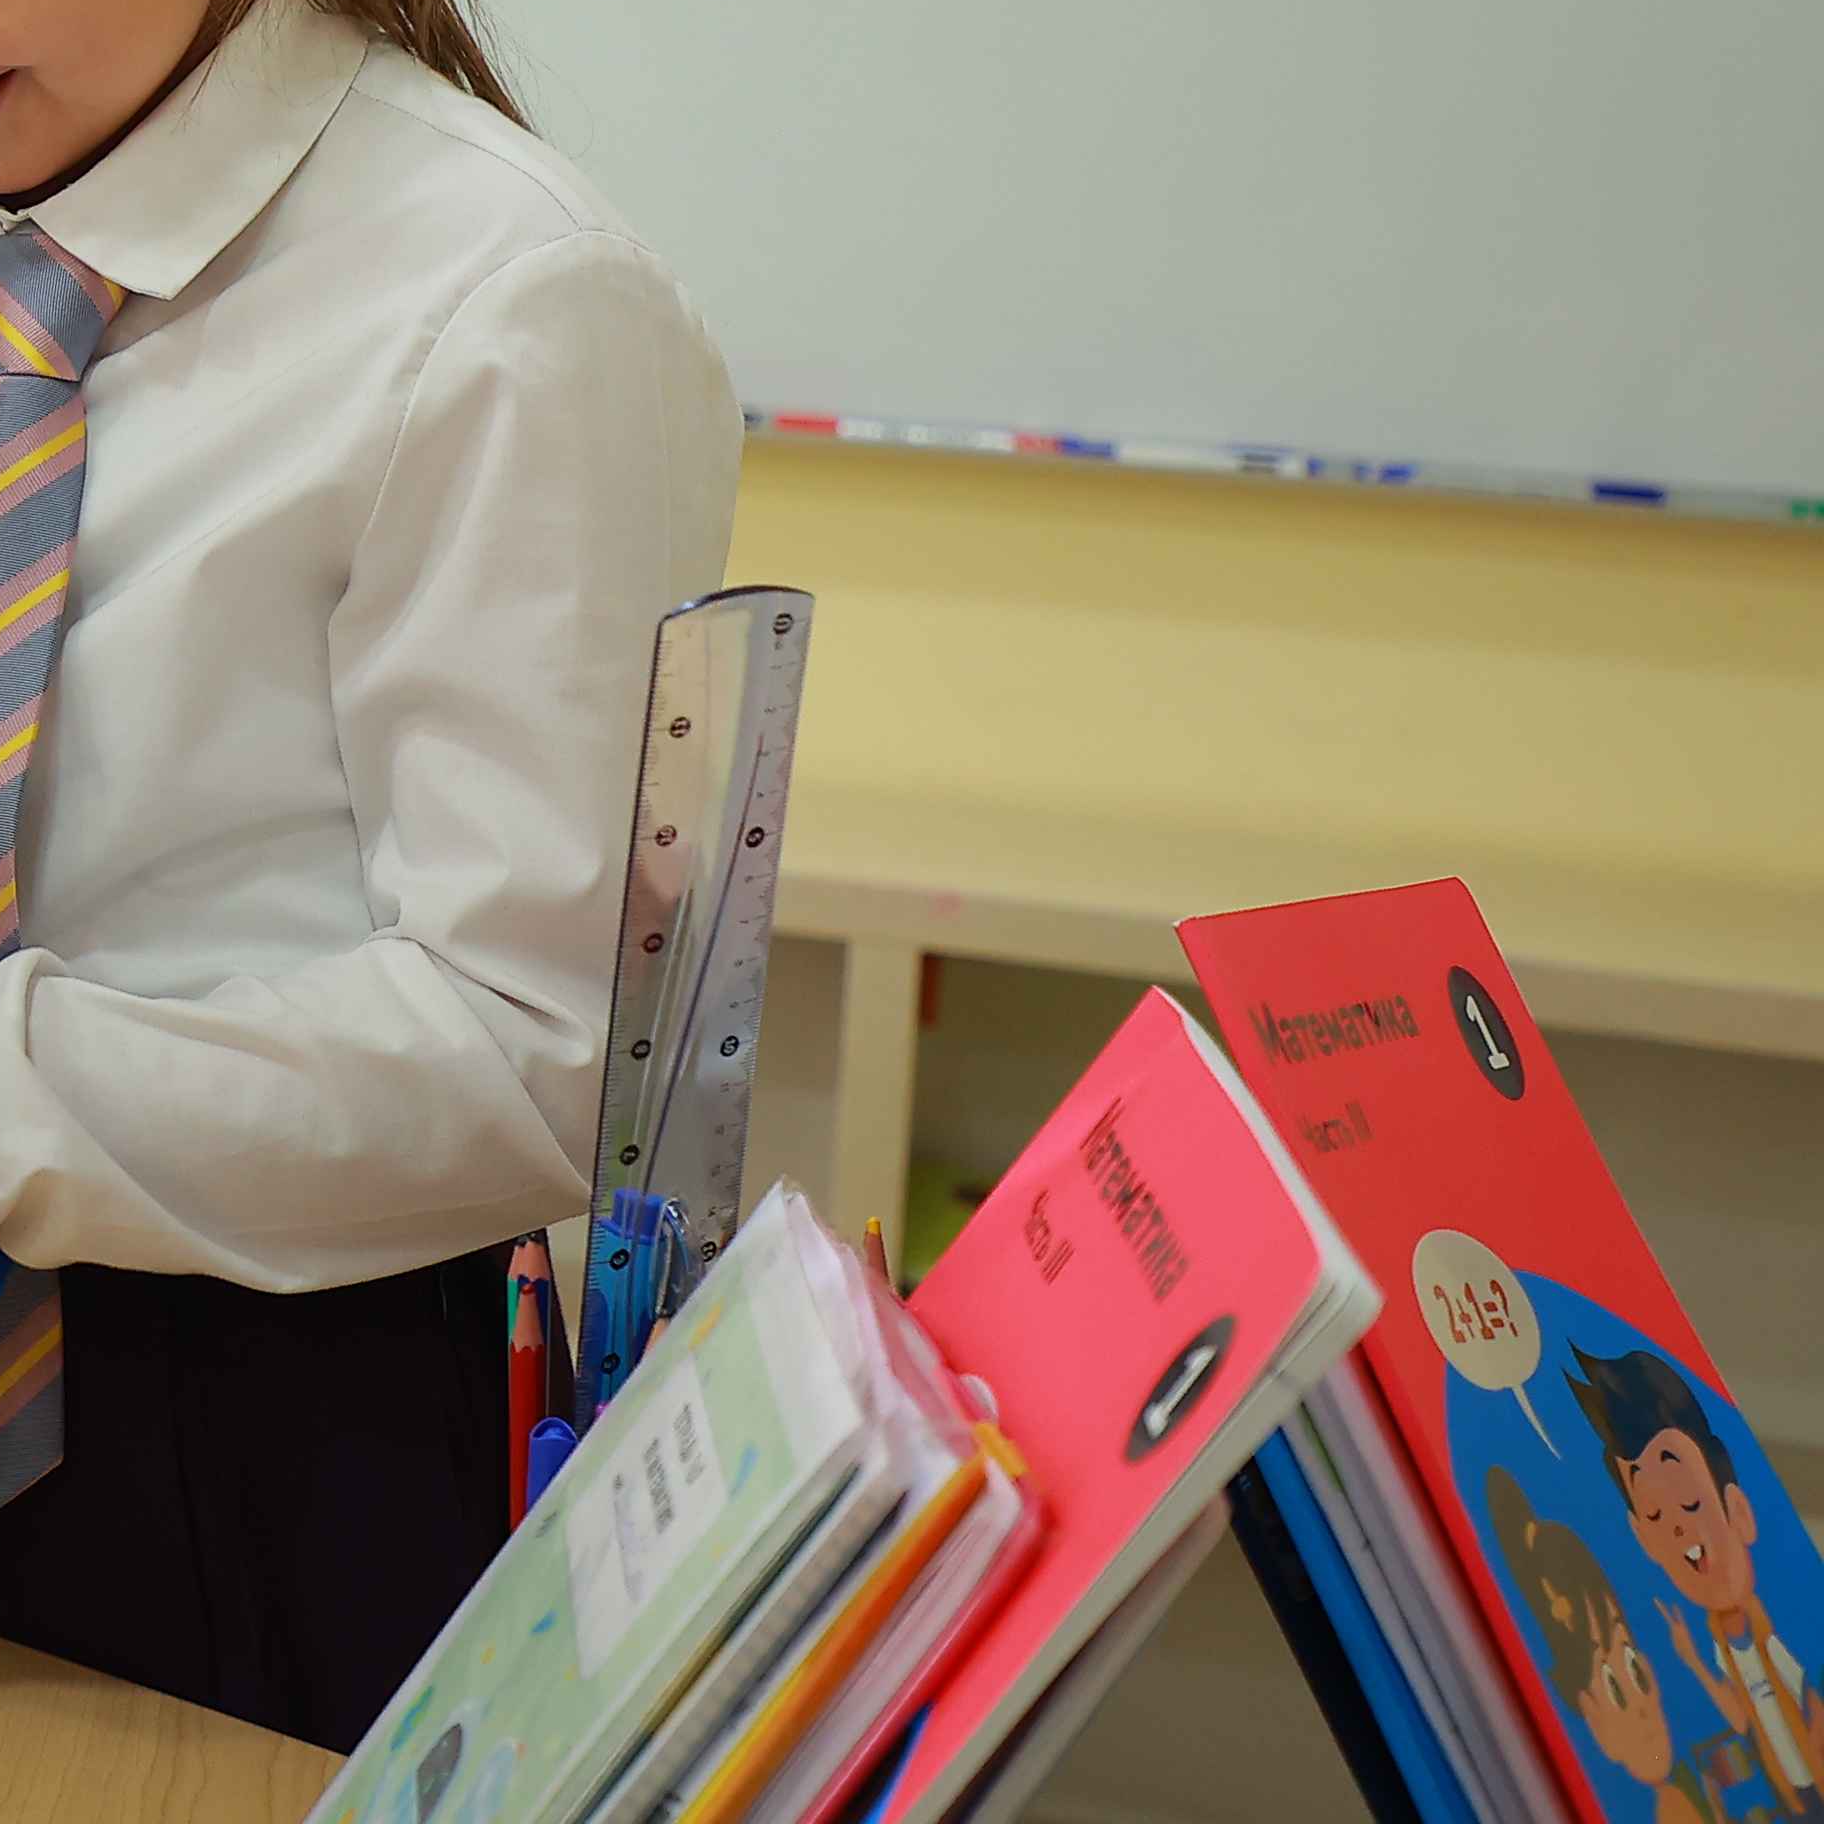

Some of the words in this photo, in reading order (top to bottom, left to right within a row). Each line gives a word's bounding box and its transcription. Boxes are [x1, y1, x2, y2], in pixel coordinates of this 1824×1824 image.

[1248, 993, 1420, 1066] Математика
[1465, 995, 1510, 1069] 1
[1080, 1097, 1190, 1303] Математика
[1433, 1279, 1519, 1344] 2+1=?
[1144, 1344, 1218, 1440] 1
